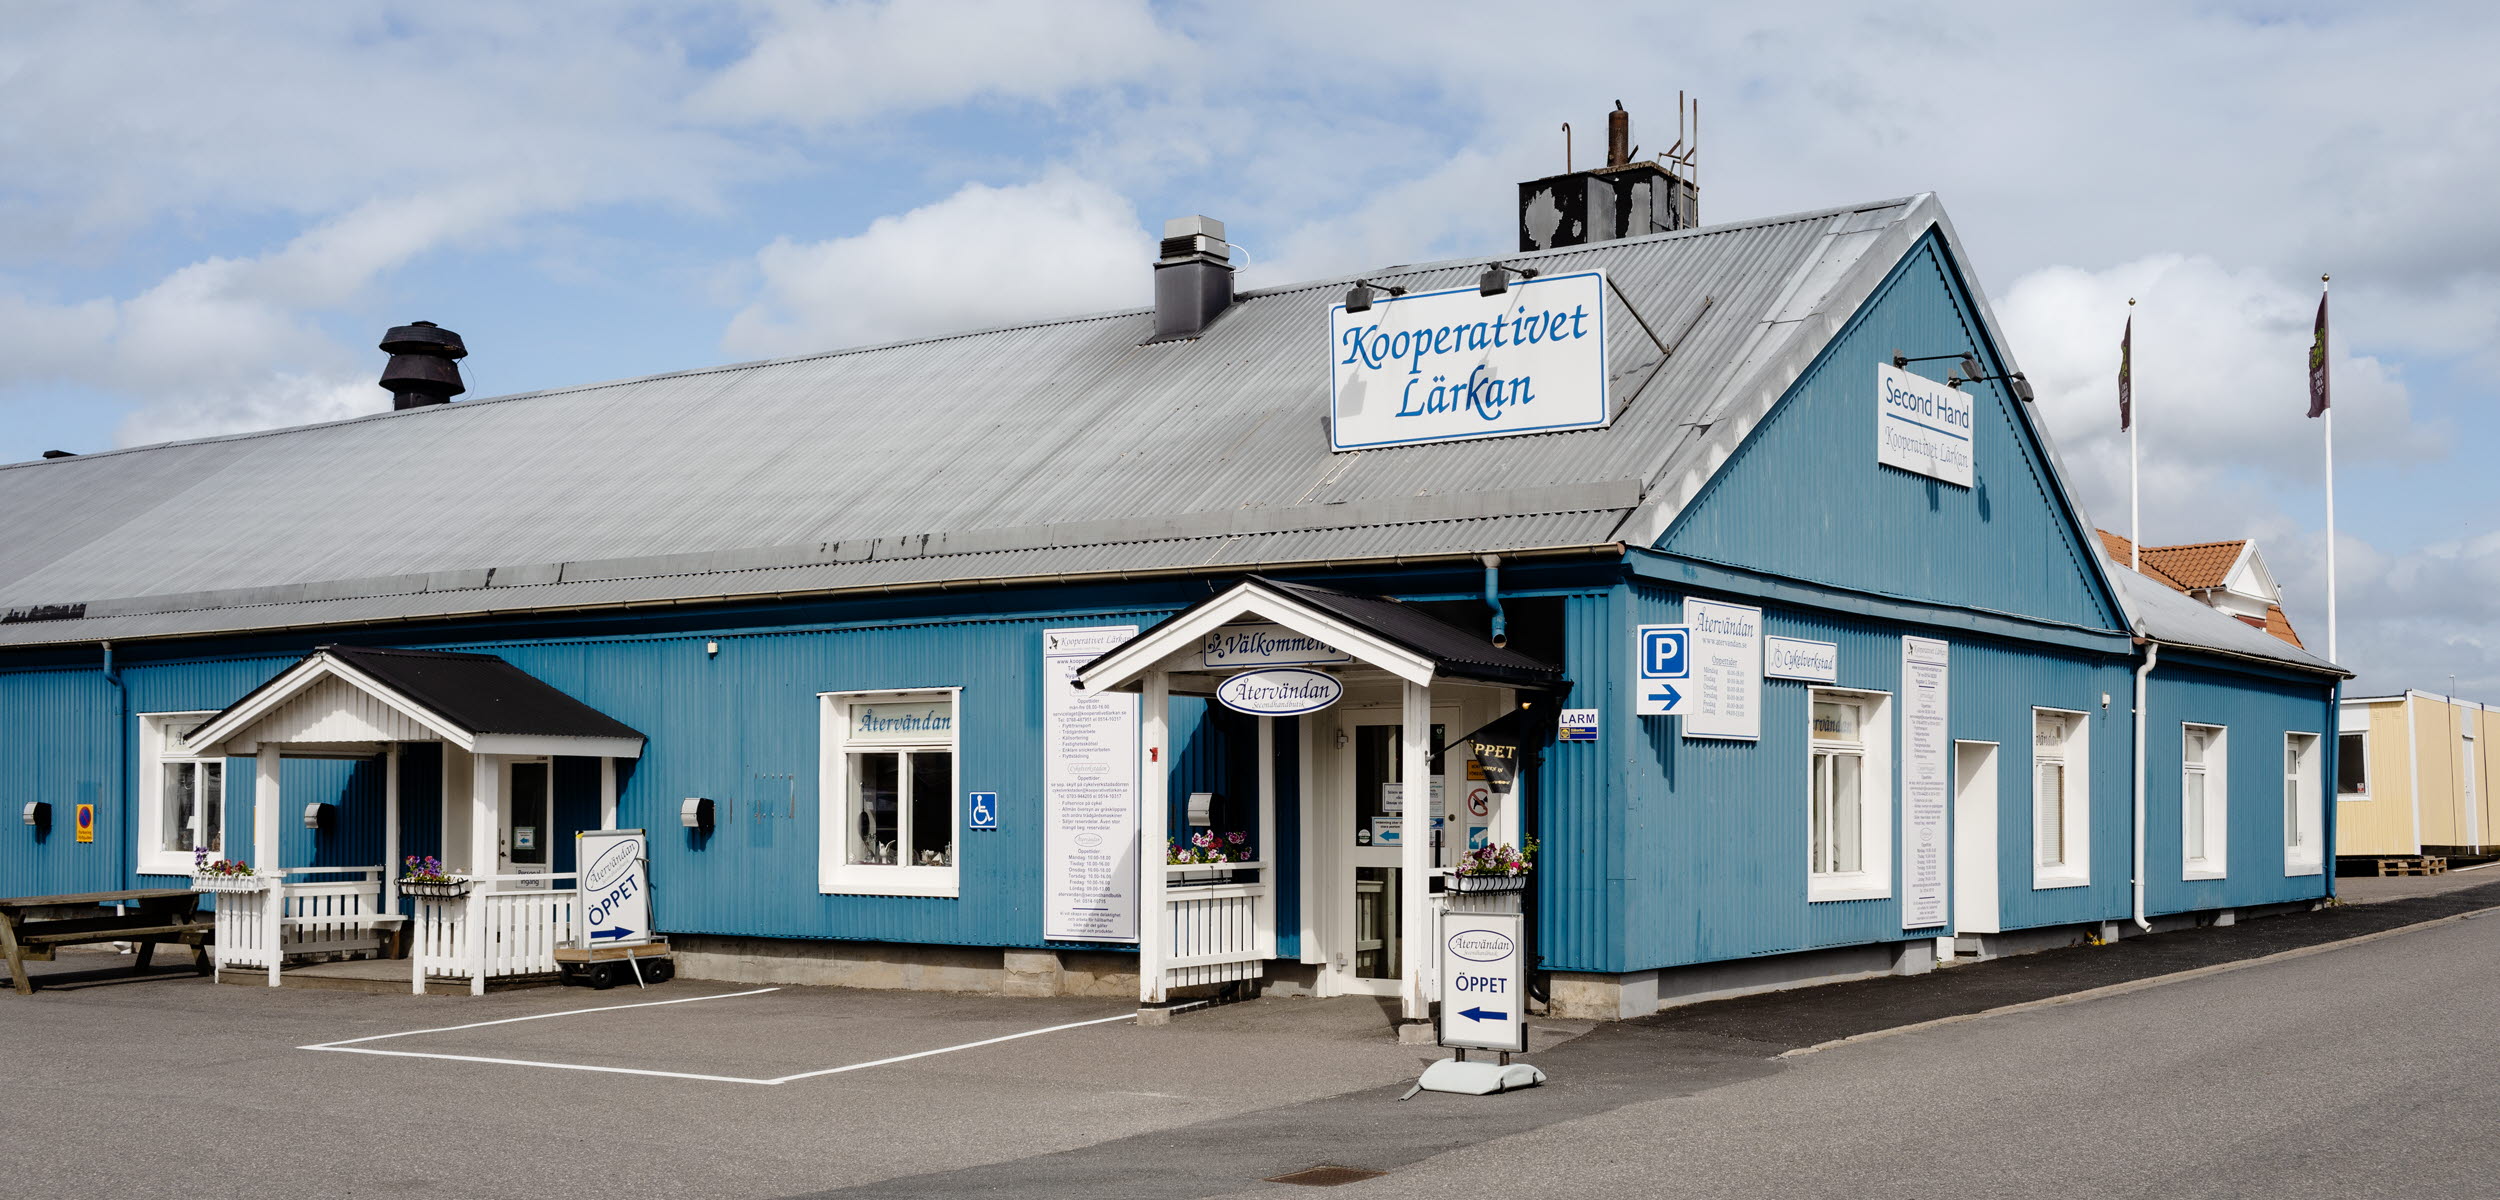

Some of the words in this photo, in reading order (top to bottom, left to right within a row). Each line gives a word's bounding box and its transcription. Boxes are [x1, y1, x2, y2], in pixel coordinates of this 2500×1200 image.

[1342, 304, 1588, 374] Kooperativet
[1395, 364, 1535, 421] Lärkan
[1886, 377, 1932, 416] Second
[1937, 395, 1969, 428] Hand
[1885, 426, 1938, 459] Kooperativet
[1940, 443, 1968, 472] Lärkan
[1695, 606, 1754, 637] Återvändan
[1061, 636, 1104, 647] Kooperativet
[1225, 632, 1327, 657] Välkommen
[1656, 637, 1678, 670] P
[1783, 649, 1834, 671] Cykelverkstad
[1230, 678, 1330, 703] Återvändan
[1252, 701, 1306, 709] Secondhandbutik
[859, 708, 951, 732] Återvändan
[1561, 714, 1595, 724] LARM
[590, 842, 636, 889] Återvändan
[588, 873, 639, 926] ÖPPET
[1452, 935, 1510, 950] Återvändan
[1455, 972, 1508, 994] ÖPPET
